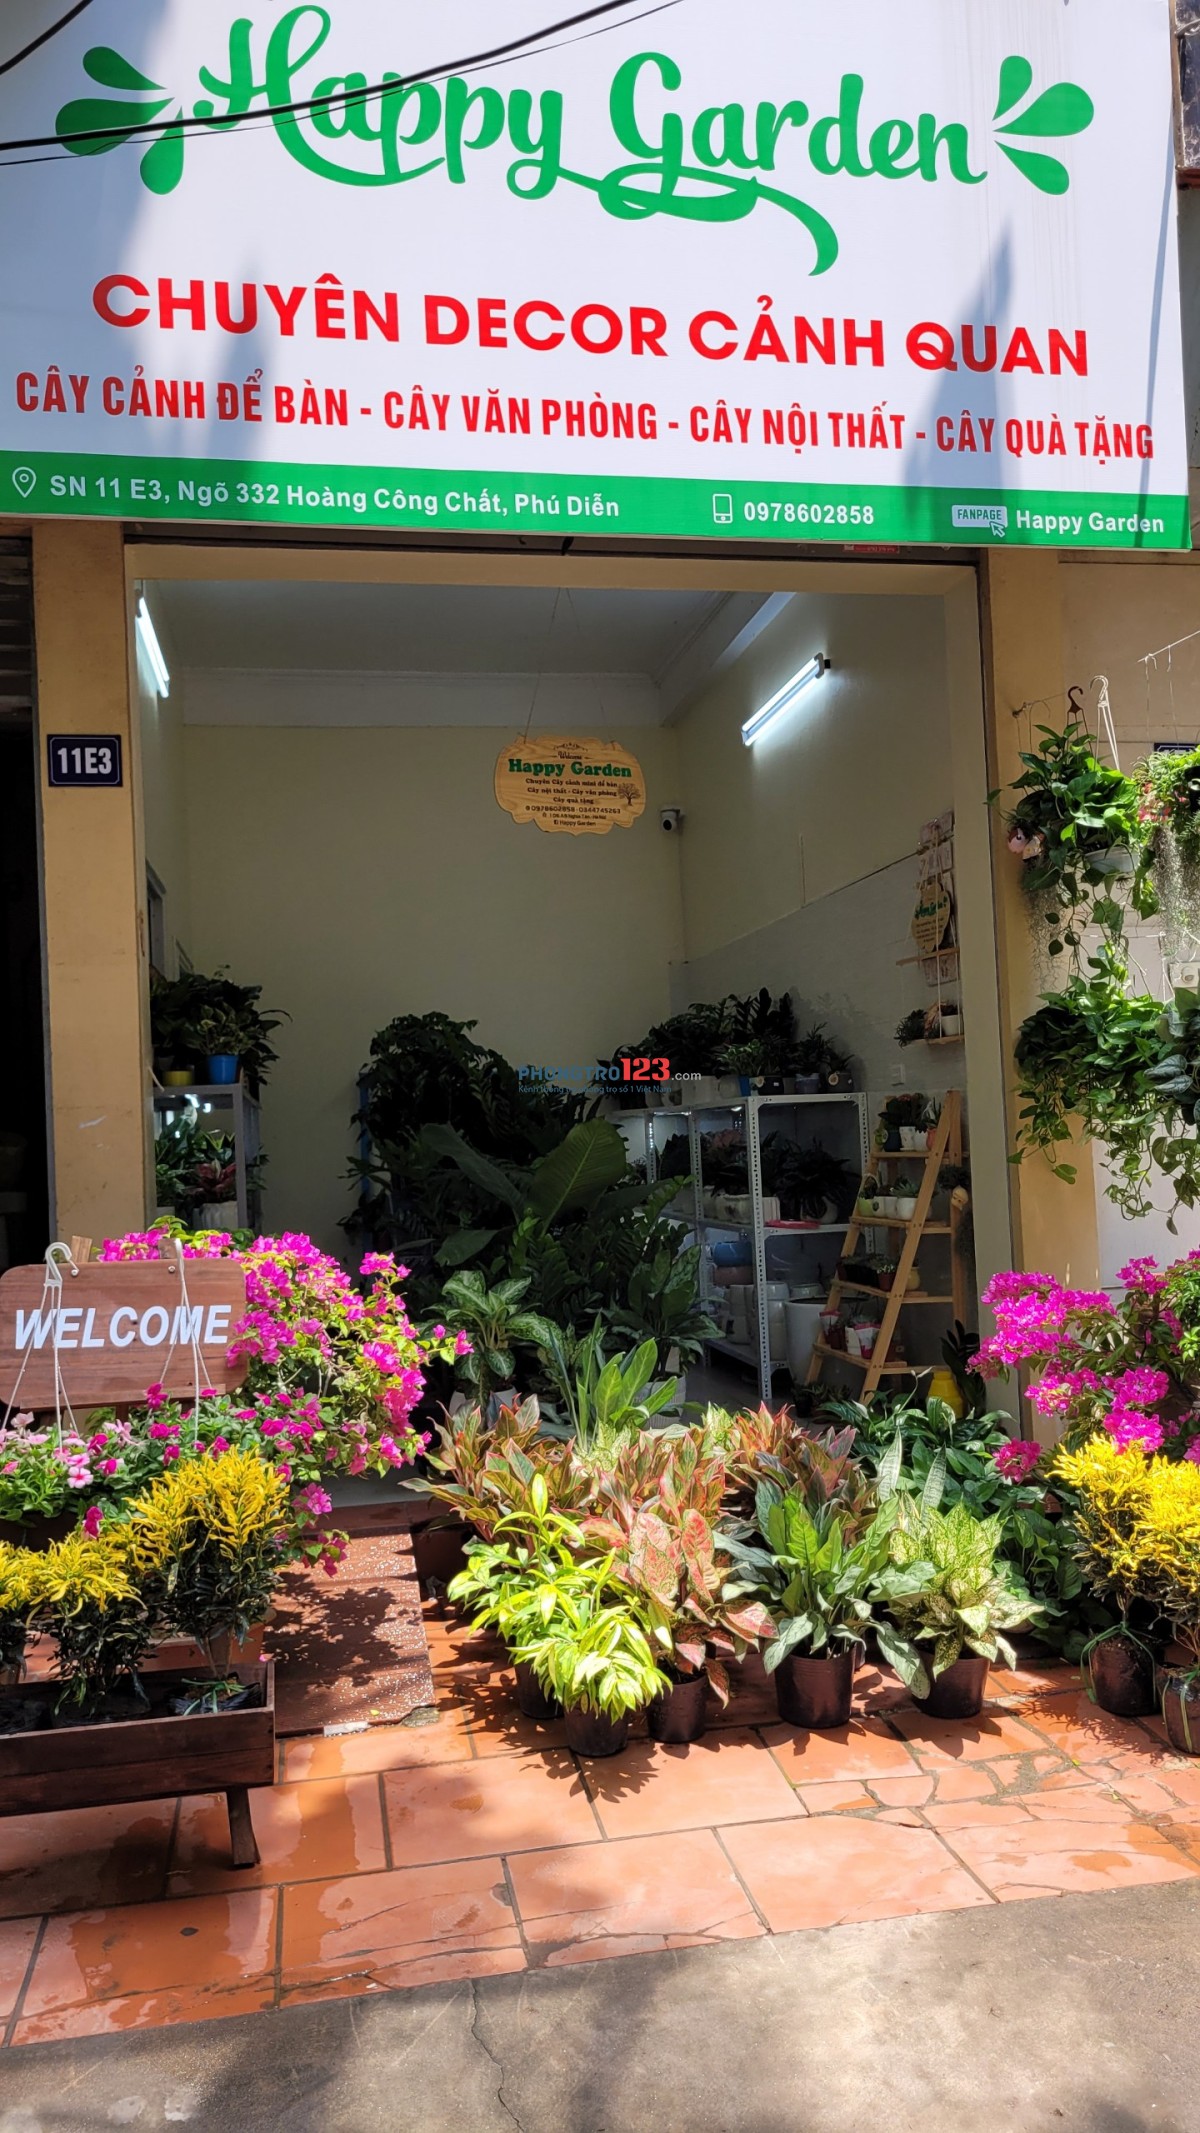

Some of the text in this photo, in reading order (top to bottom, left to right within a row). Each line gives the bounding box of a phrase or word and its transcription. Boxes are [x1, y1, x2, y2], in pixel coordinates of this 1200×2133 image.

[193, 5, 988, 276] Happy Garden
[92, 272, 1089, 377] CHUYÊN DECOR CẢNH QUAN
[16, 364, 89, 414] CÂY
[102, 364, 206, 420] CẢNH
[216, 368, 263, 422] ĐỂ
[274, 379, 349, 427] BÀN
[384, 384, 451, 432] CÂY
[460, 388, 531, 435] VĂN
[541, 391, 658, 441] PHÒNG
[689, 399, 753, 444] CÂY
[762, 402, 819, 455] NỘI
[827, 401, 906, 450] THẤT
[935, 409, 995, 454] CÂY
[1005, 413, 1067, 458] QUÀ
[1073, 415, 1154, 466] TẶNG
[50, 475, 620, 517] SN 11 E3, Ngõ 332 Hoàng Công Chất, Phú Diễn
[743, 501, 875, 525] 0978602858
[957, 508, 1165, 535] FANPAGE Happy Garden
[57, 747, 112, 774] 11E3
[508, 758, 632, 777] Happy Garden
[15, 1304, 232, 1350] WELCOME
